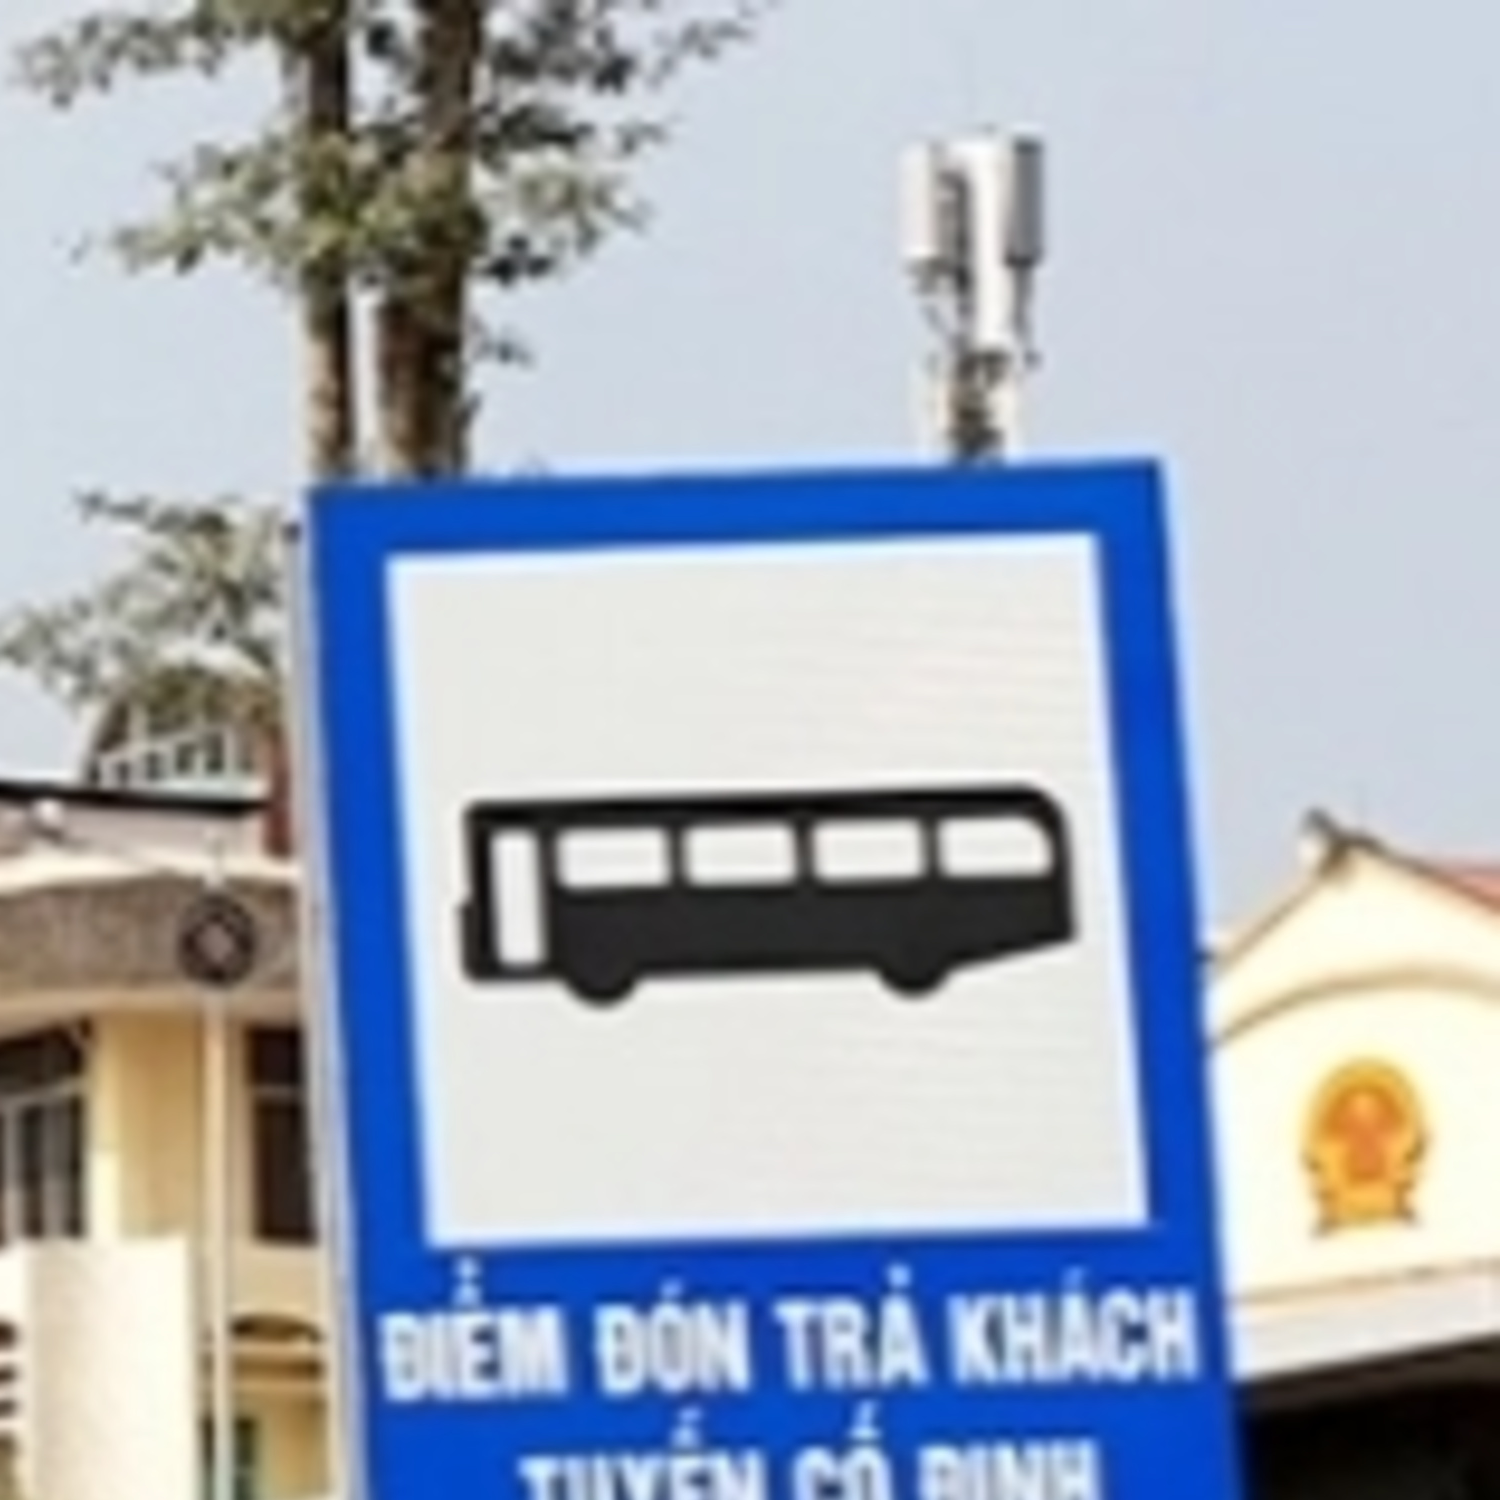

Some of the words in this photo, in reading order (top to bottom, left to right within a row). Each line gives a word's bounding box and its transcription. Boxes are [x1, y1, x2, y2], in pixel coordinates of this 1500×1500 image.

[381, 1258, 566, 1398] ĐIỂM
[595, 1280, 751, 1393] ĐÓN
[777, 1265, 926, 1388] TRẢ
[948, 1268, 1197, 1382] KHÁCH
